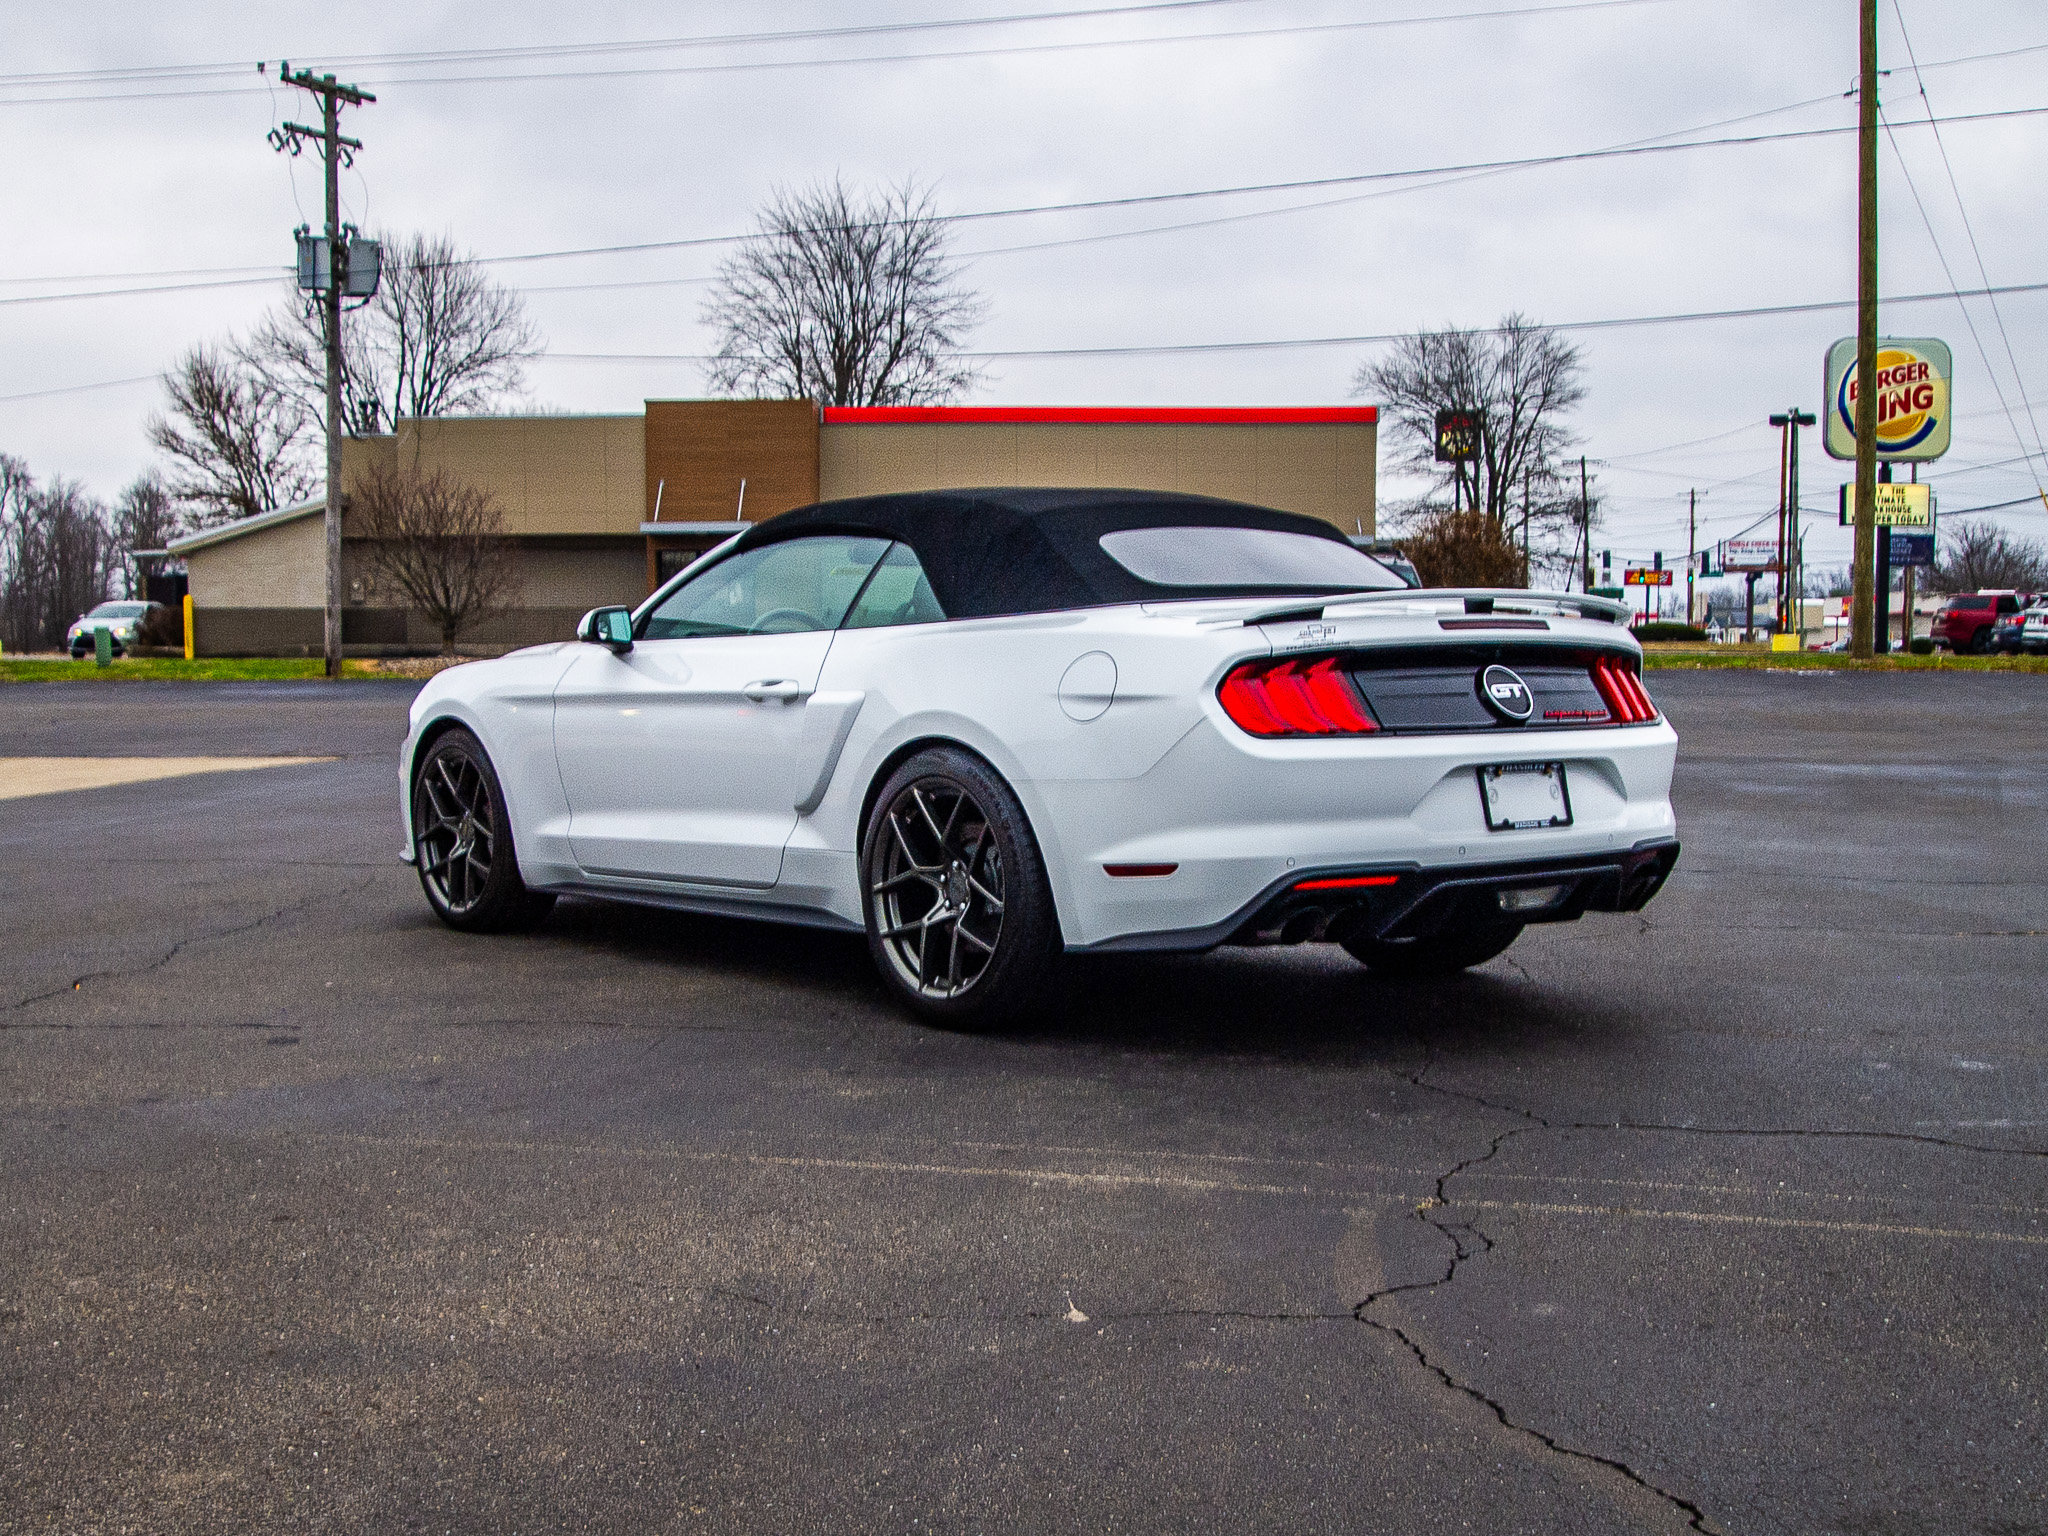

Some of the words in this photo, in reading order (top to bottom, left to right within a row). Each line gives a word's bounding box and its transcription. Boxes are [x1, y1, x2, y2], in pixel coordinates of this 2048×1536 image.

[1850, 362, 1929, 402] BRGER
[1877, 383, 1934, 423] ING
[1876, 496, 1905, 504] TIMATE
[1896, 515, 1925, 524] TODAY
[1490, 683, 1522, 699] GT
